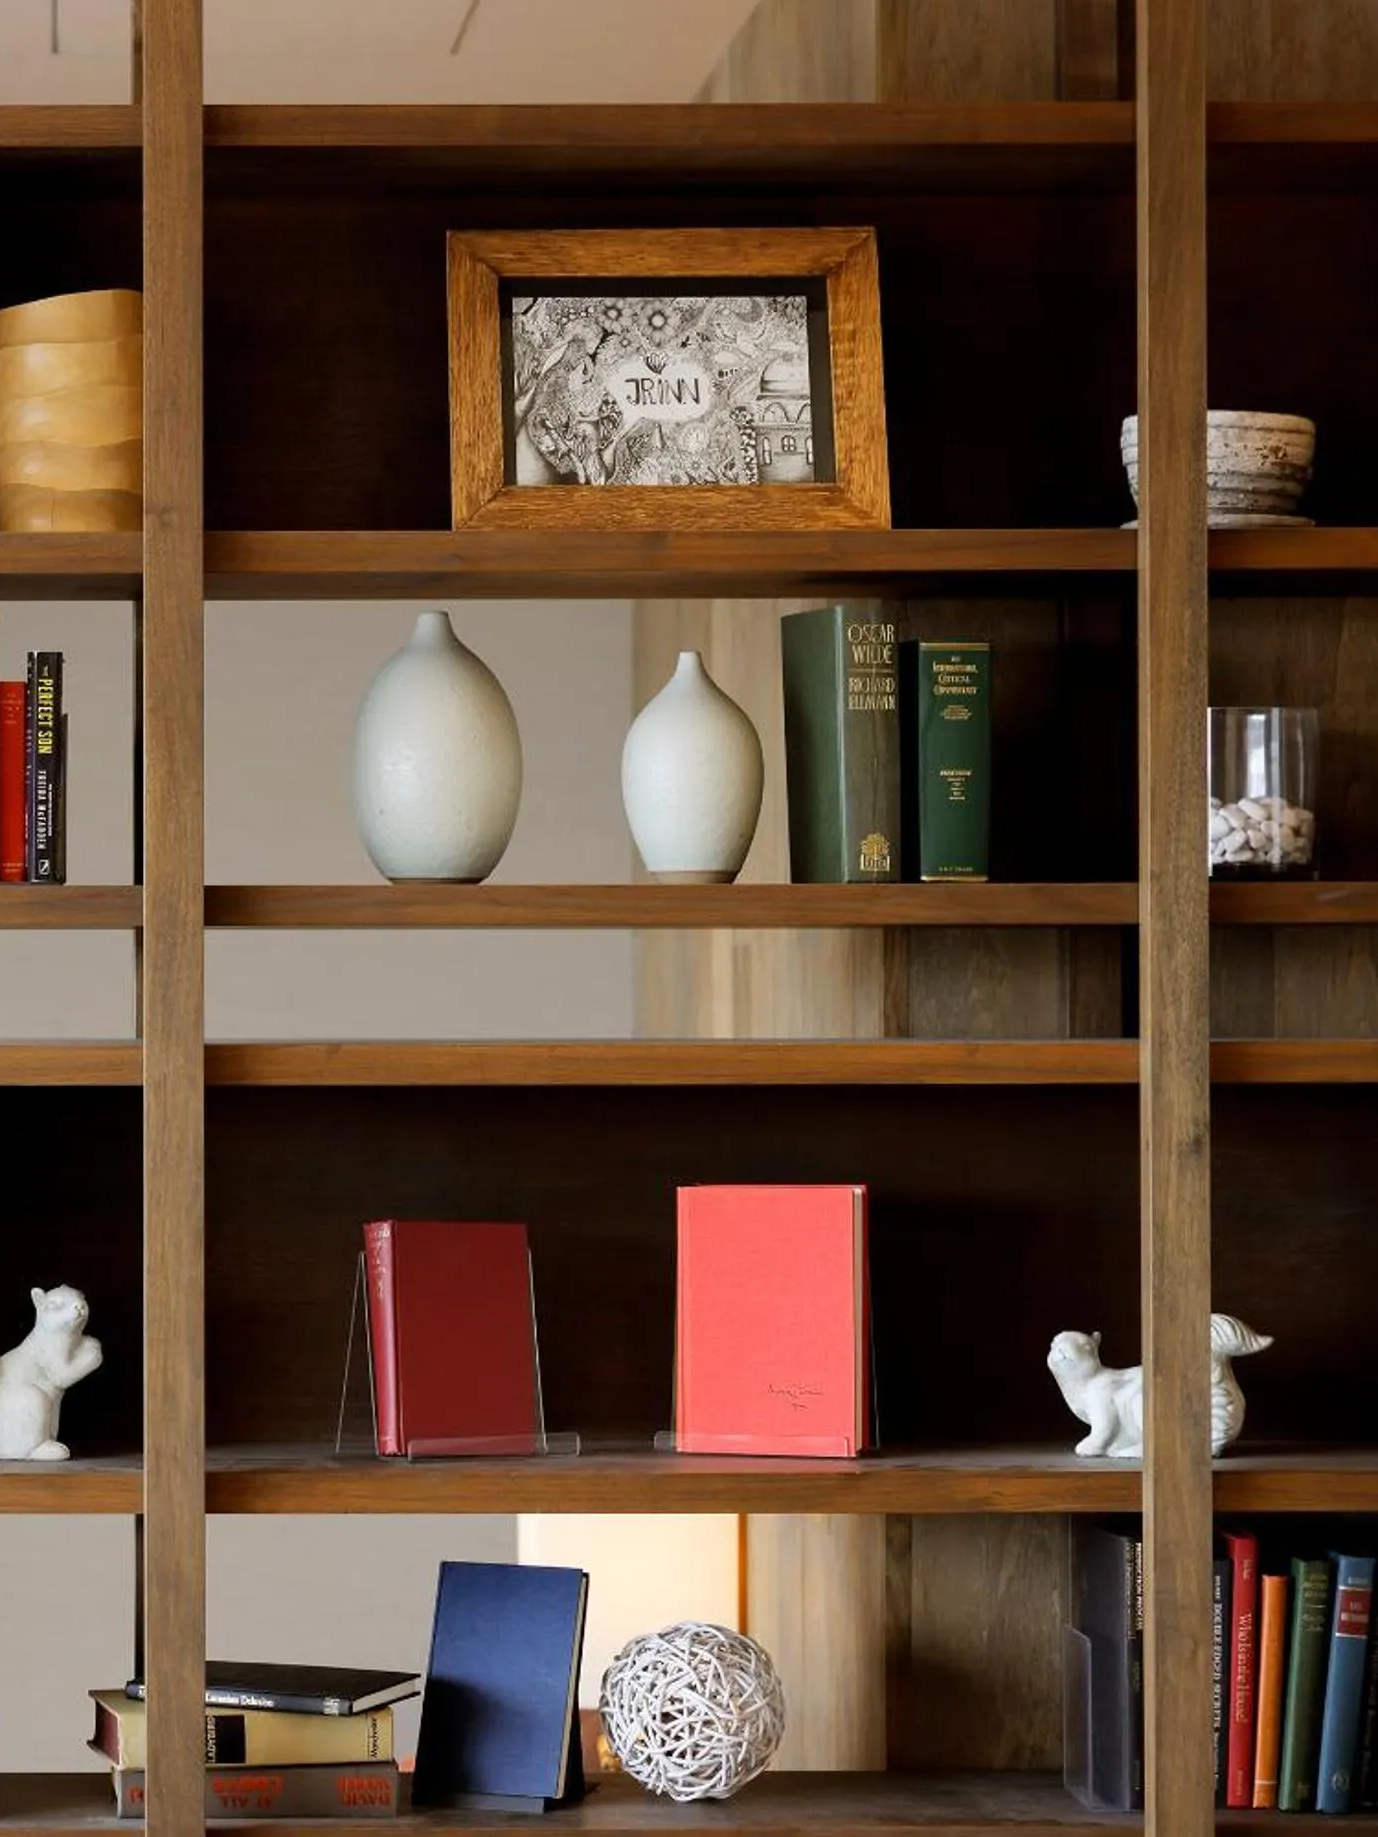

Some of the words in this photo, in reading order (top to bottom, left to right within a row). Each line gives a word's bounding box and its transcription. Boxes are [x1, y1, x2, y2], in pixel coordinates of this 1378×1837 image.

[848, 623, 894, 643] OSCAR
[851, 645, 893, 664] WILDE
[38, 679, 54, 728] PERFECT
[38, 731, 53, 754] SON
[1238, 1612, 1253, 1641] Who
